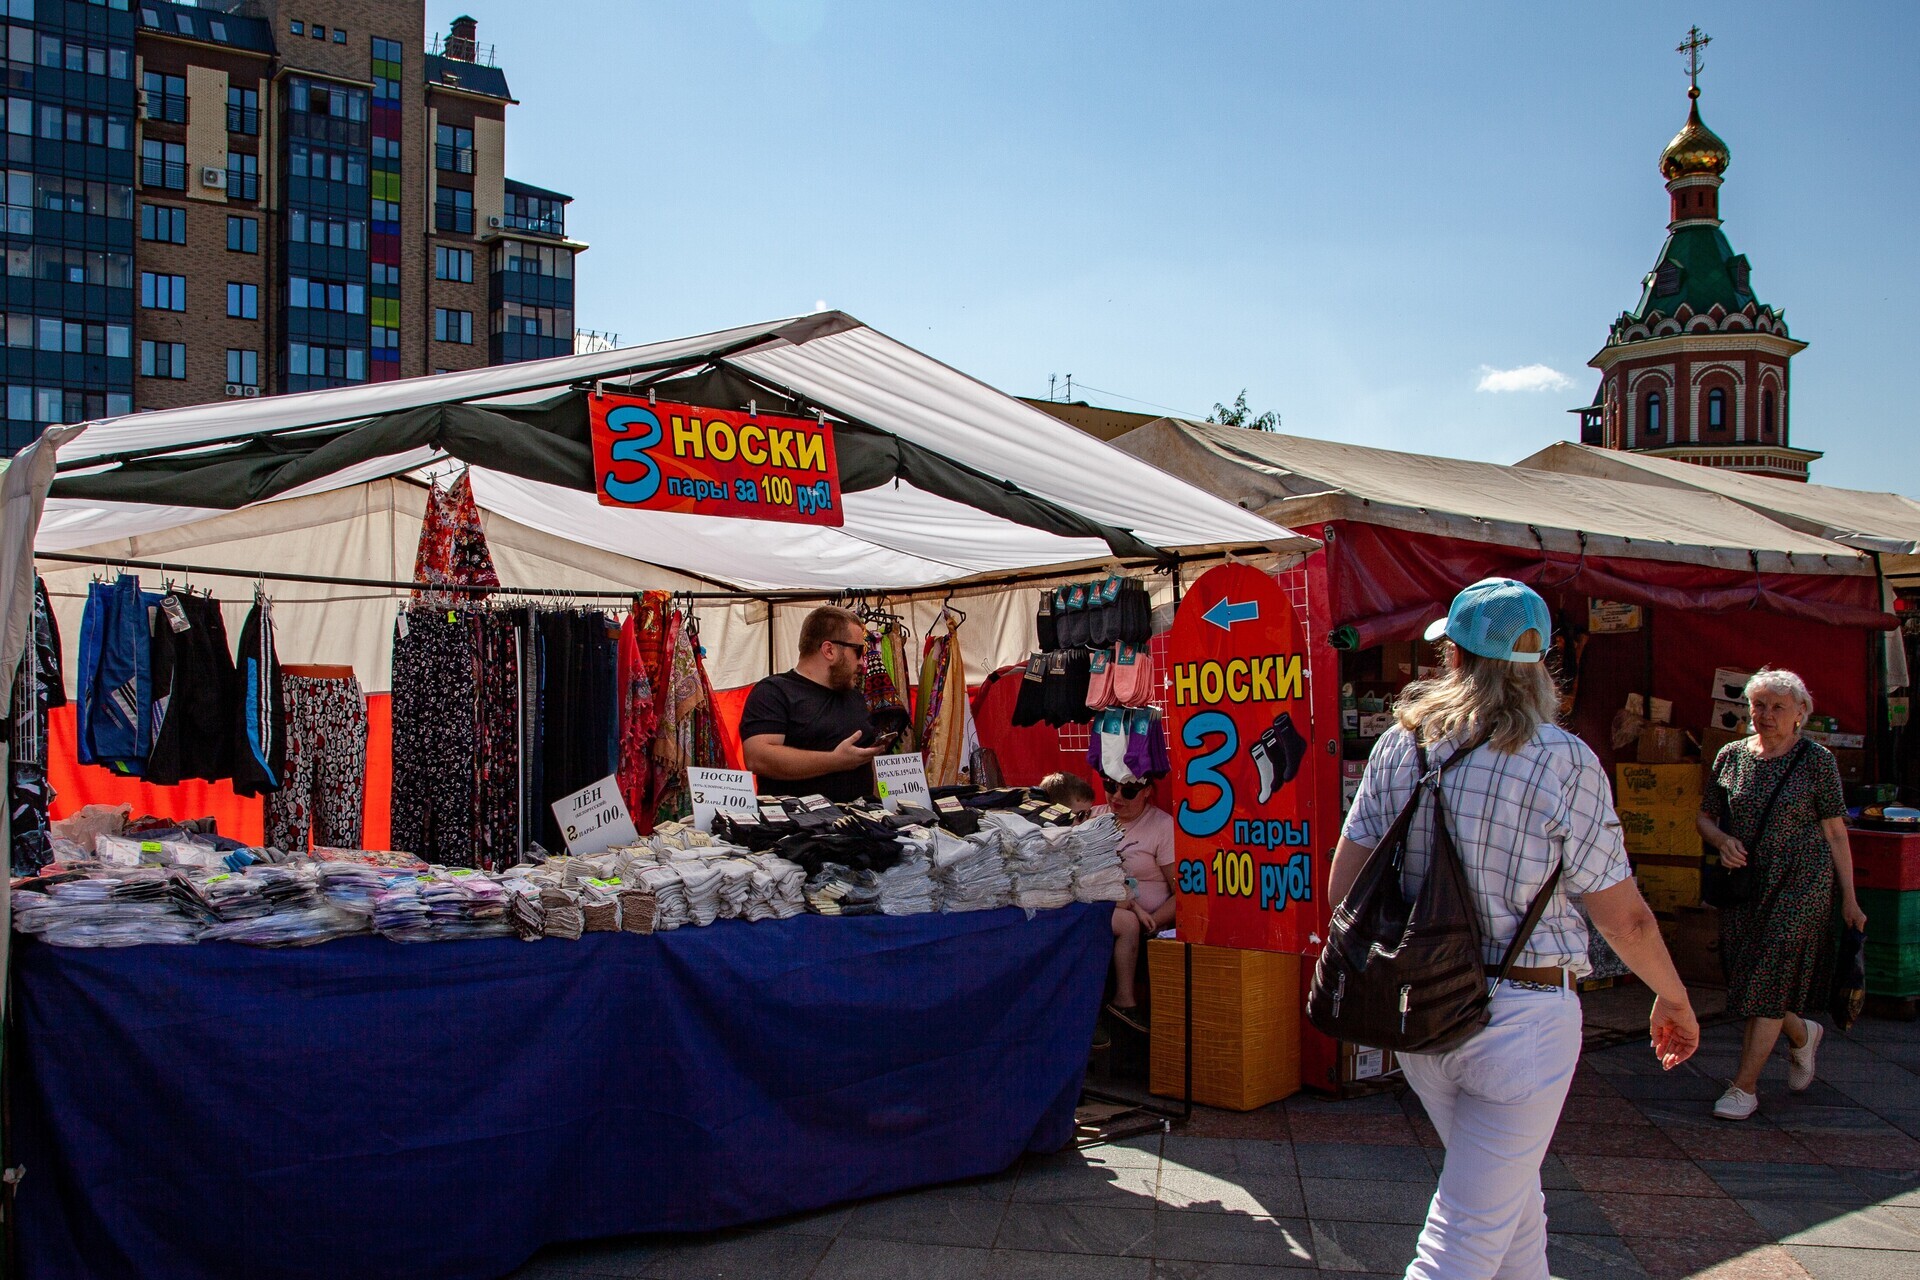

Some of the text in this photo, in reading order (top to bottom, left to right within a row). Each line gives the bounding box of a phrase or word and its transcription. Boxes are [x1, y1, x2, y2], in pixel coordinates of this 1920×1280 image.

[604, 405, 832, 515] 3 пары за 100 руб!
[670, 414, 828, 472] НОСКИ
[1173, 653, 1304, 706] НОСКИ
[700, 771, 743, 783] НОСКИ
[876, 756, 921, 767] НОСКИ МУЖ.
[1177, 710, 1310, 850] 3 пары
[573, 787, 602, 811] ЛЁН
[693, 792, 705, 804] 3
[722, 795, 747, 808] 100
[903, 781, 920, 794] 100
[1178, 850, 1312, 911] за 100 руб!
